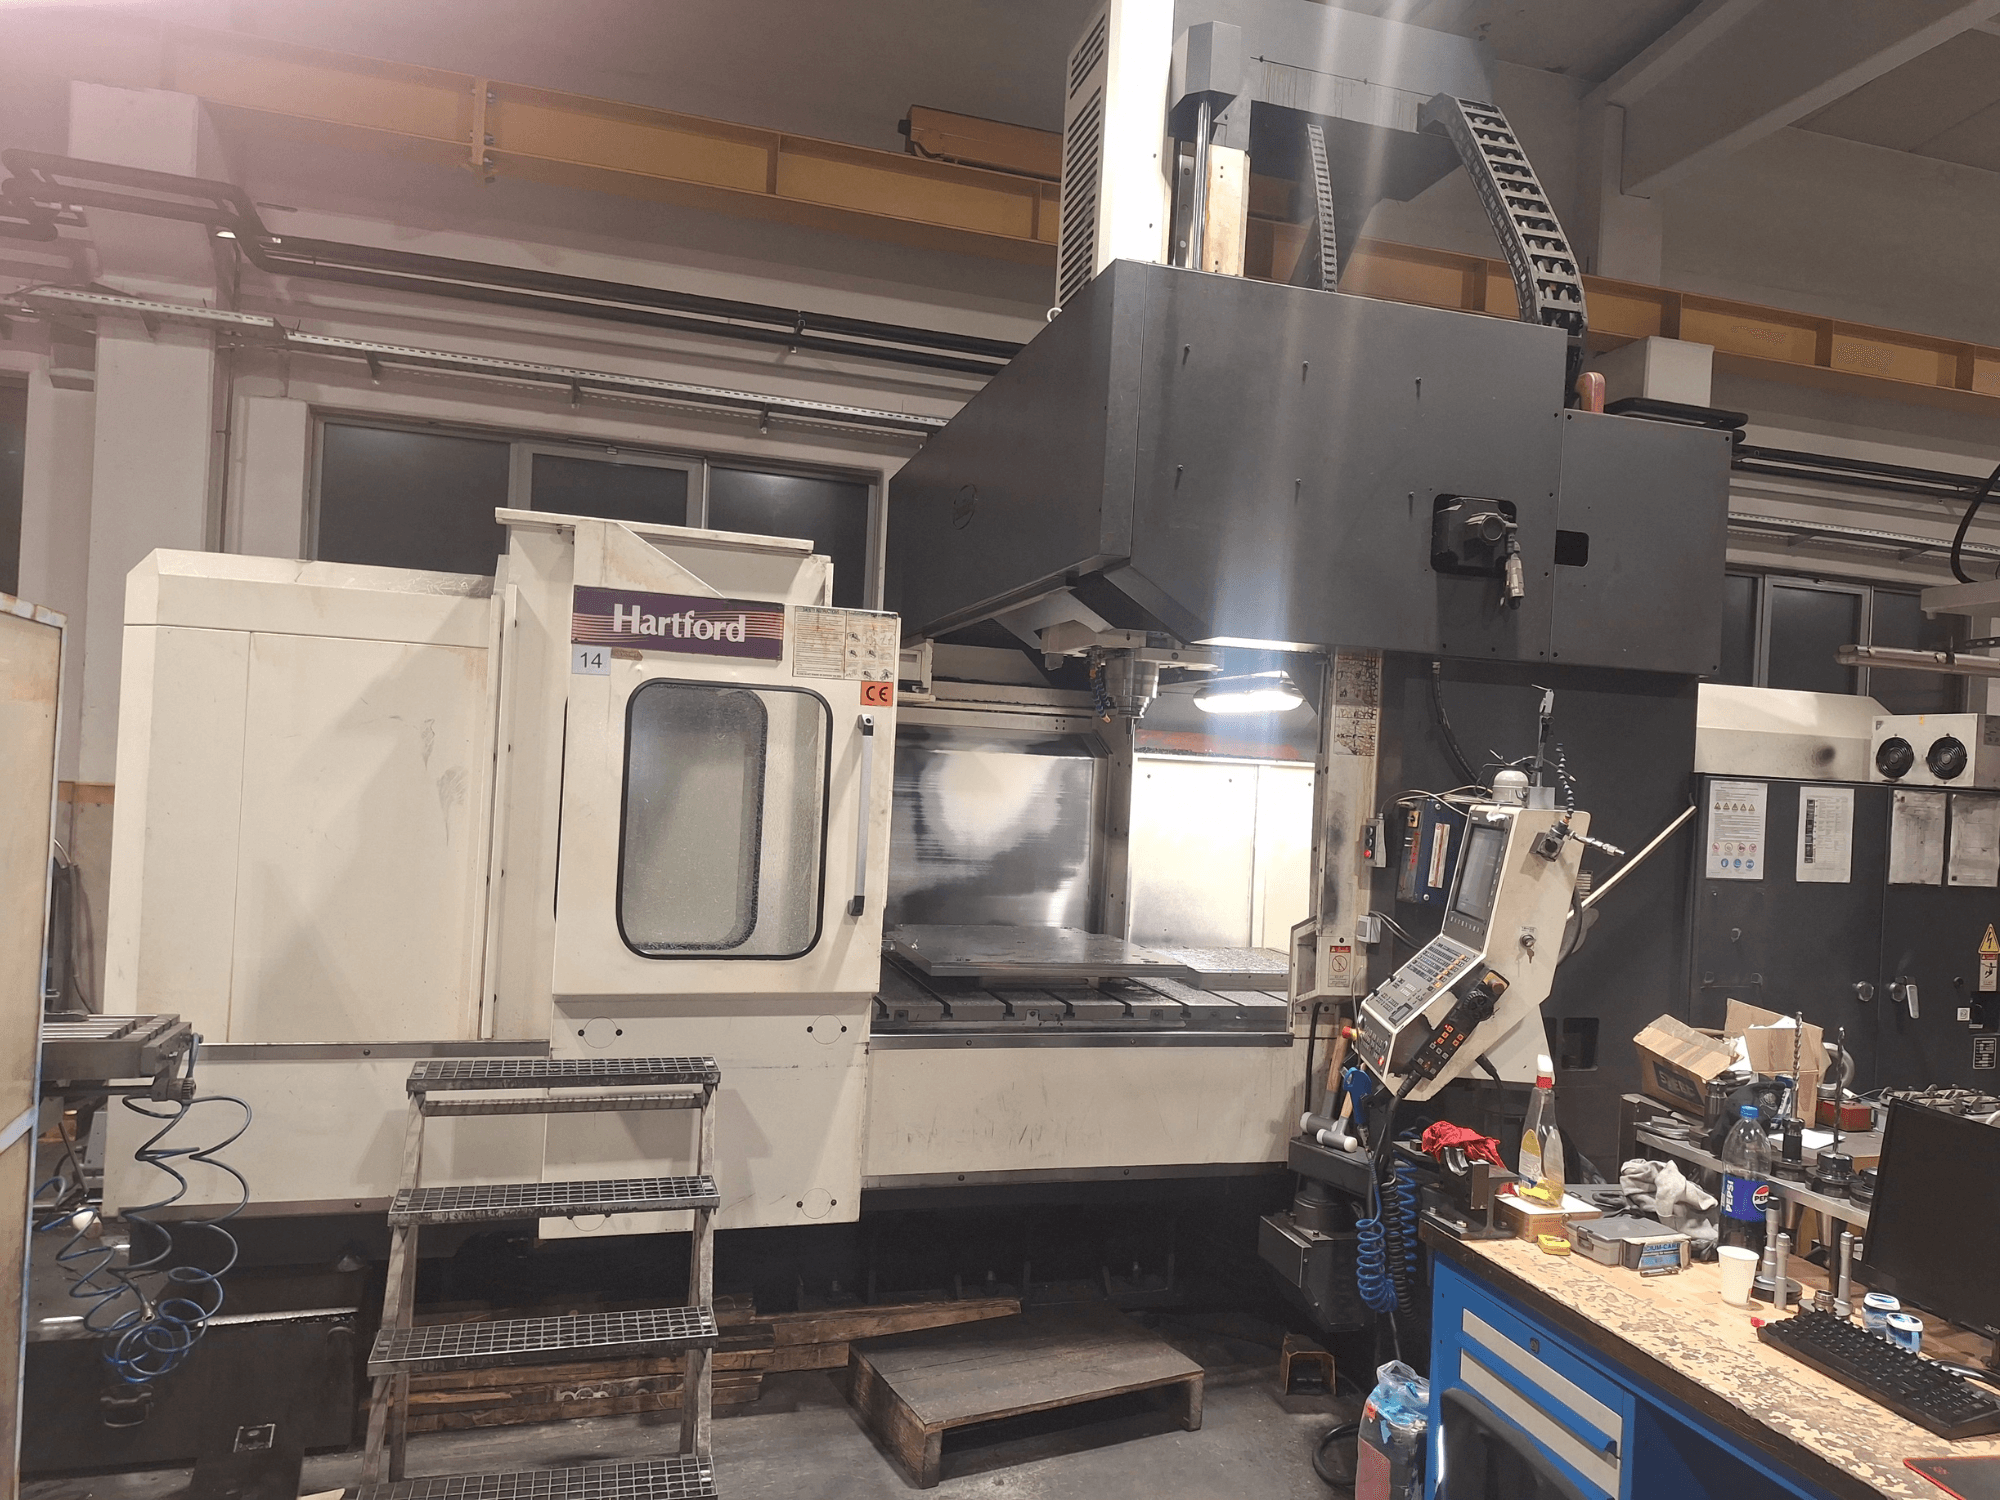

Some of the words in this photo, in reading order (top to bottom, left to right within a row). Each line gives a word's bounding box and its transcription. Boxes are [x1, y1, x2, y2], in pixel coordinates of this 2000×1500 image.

[613, 603, 746, 643] Hartford
[580, 652, 603, 669] 14
[866, 685, 889, 702] CE
[1725, 1180, 1734, 1213] PEPSI
